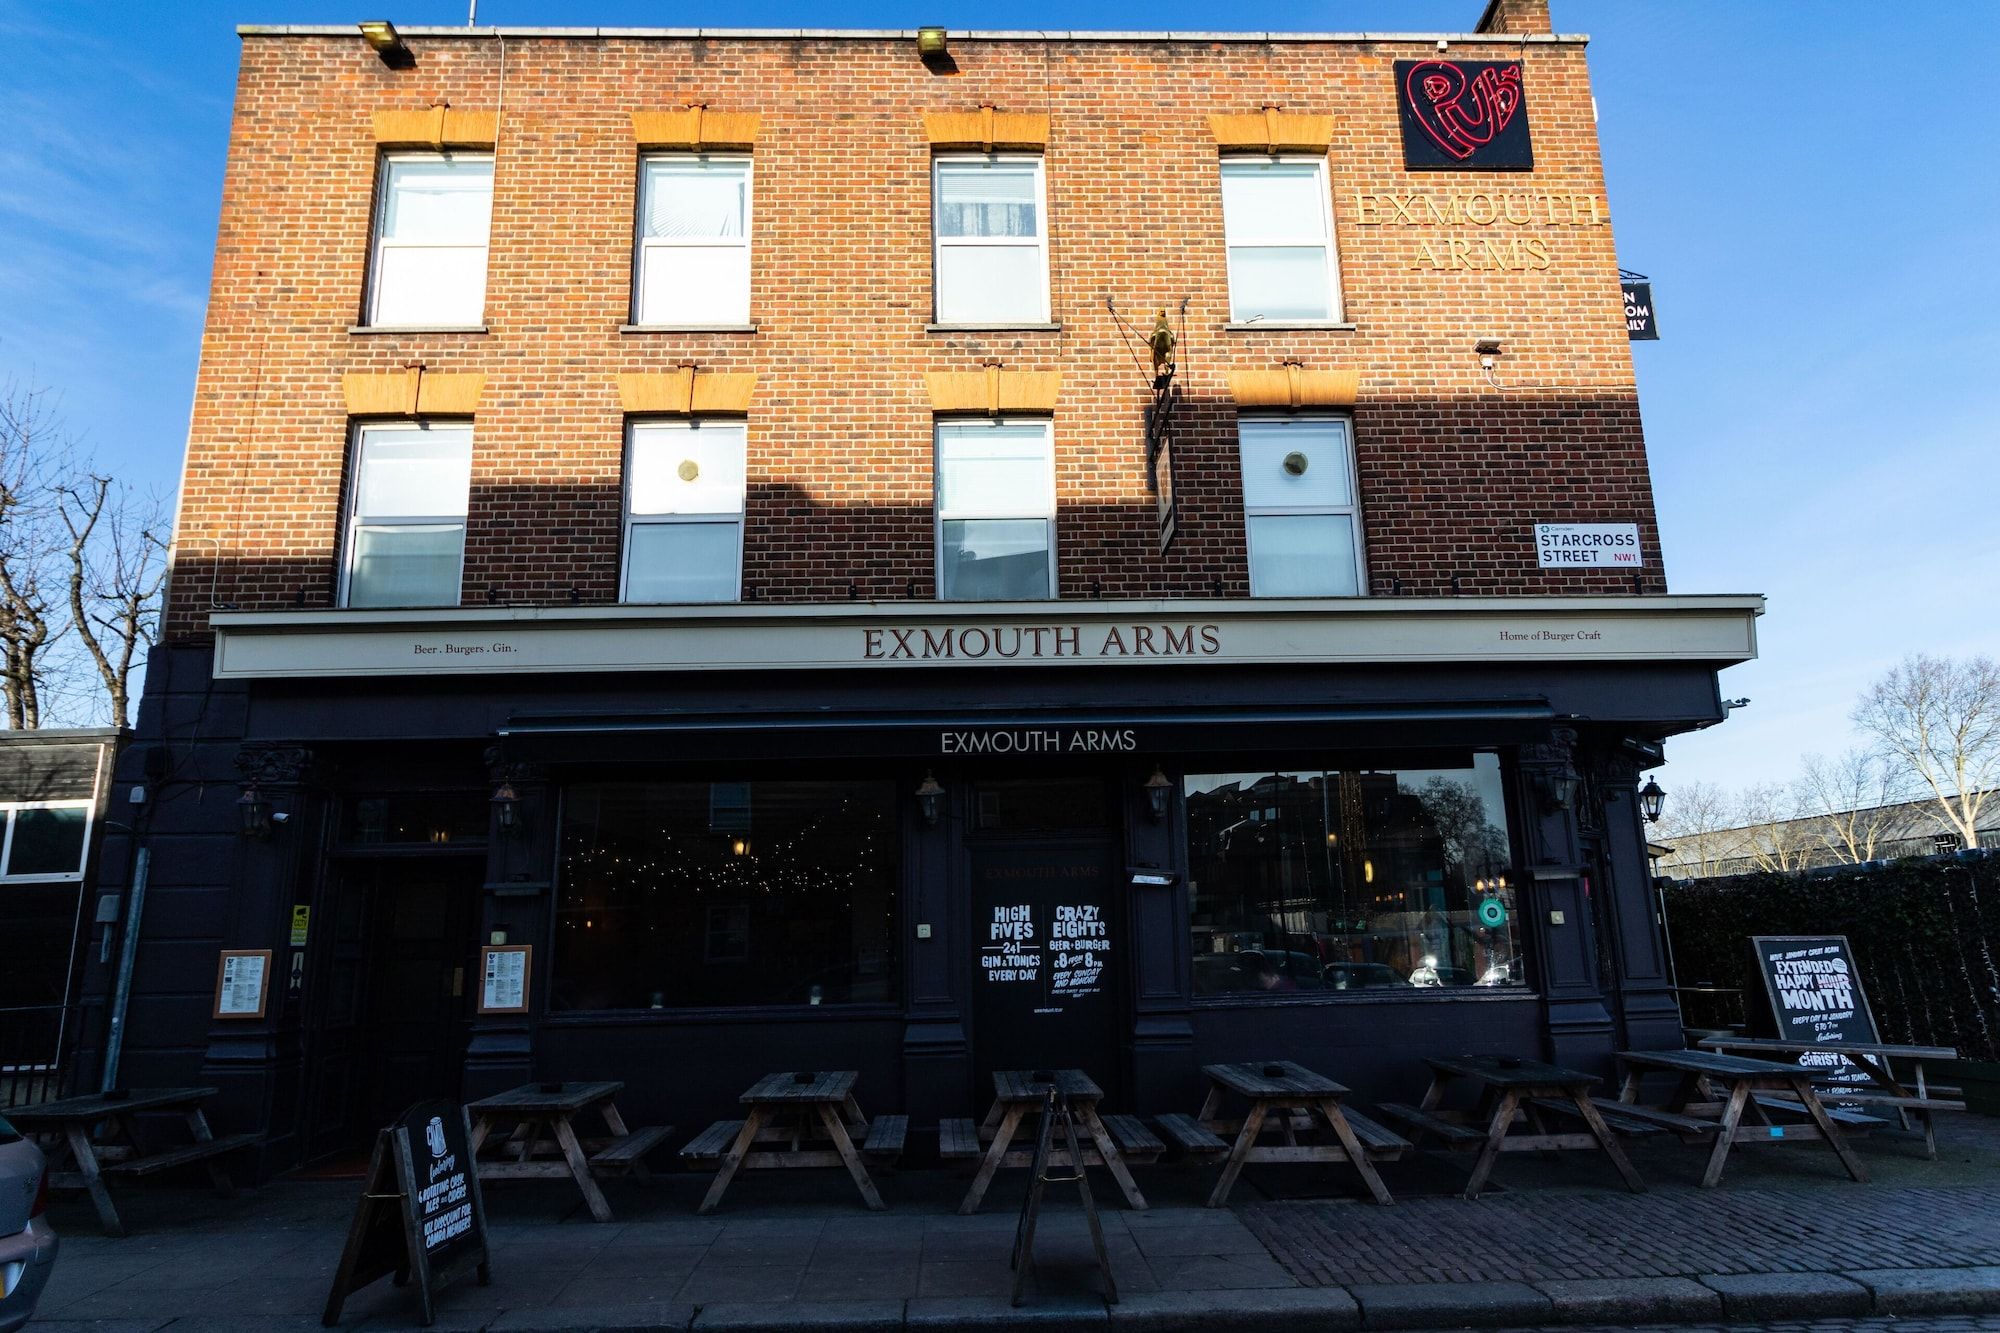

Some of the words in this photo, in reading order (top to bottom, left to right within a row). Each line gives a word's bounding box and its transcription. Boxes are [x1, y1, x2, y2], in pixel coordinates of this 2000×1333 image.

[1353, 193, 1603, 226] EXMOUTH
[1410, 237, 1552, 271] ARMS
[1541, 534, 1635, 546] STARCROSS
[1543, 550, 1599, 562] STREET
[1614, 553, 1636, 562] NW1
[863, 626, 1081, 659] EXMOUTH
[1100, 624, 1221, 656] ARMS
[1499, 631, 1529, 641] Home
[1531, 631, 1541, 640] of
[1543, 631, 1574, 642] Burger
[1577, 631, 1601, 640] Craft
[941, 731, 1059, 753] EXMOUTH
[1069, 730, 1136, 752] ARMS
[1060, 866, 1100, 878] ARMS
[994, 905, 1030, 922] HIGH
[1056, 905, 1099, 922] CRAZY
[990, 922, 1034, 940] FIVES
[1052, 921, 1106, 938] EIGHTS
[1003, 942, 1021, 954] 241
[1049, 940, 1071, 951] BEER
[1075, 939, 1110, 951] BURGER
[982, 956, 1002, 968] GIN
[1007, 955, 1041, 968] TONICS
[1775, 960, 1833, 974] EXTENDED
[989, 970, 1017, 981] EVERY
[1019, 969, 1037, 981] DAY
[1074, 968, 1102, 977] SUNDAY
[1054, 979, 1069, 988] AND
[1070, 976, 1098, 986] MONDAY
[1774, 974, 1814, 989] HAPPY
[1816, 974, 1852, 989] HOUR
[1780, 989, 1854, 1011] MONTH
[1792, 1015, 1809, 1024] EVERY
[1810, 1014, 1821, 1023] DAY
